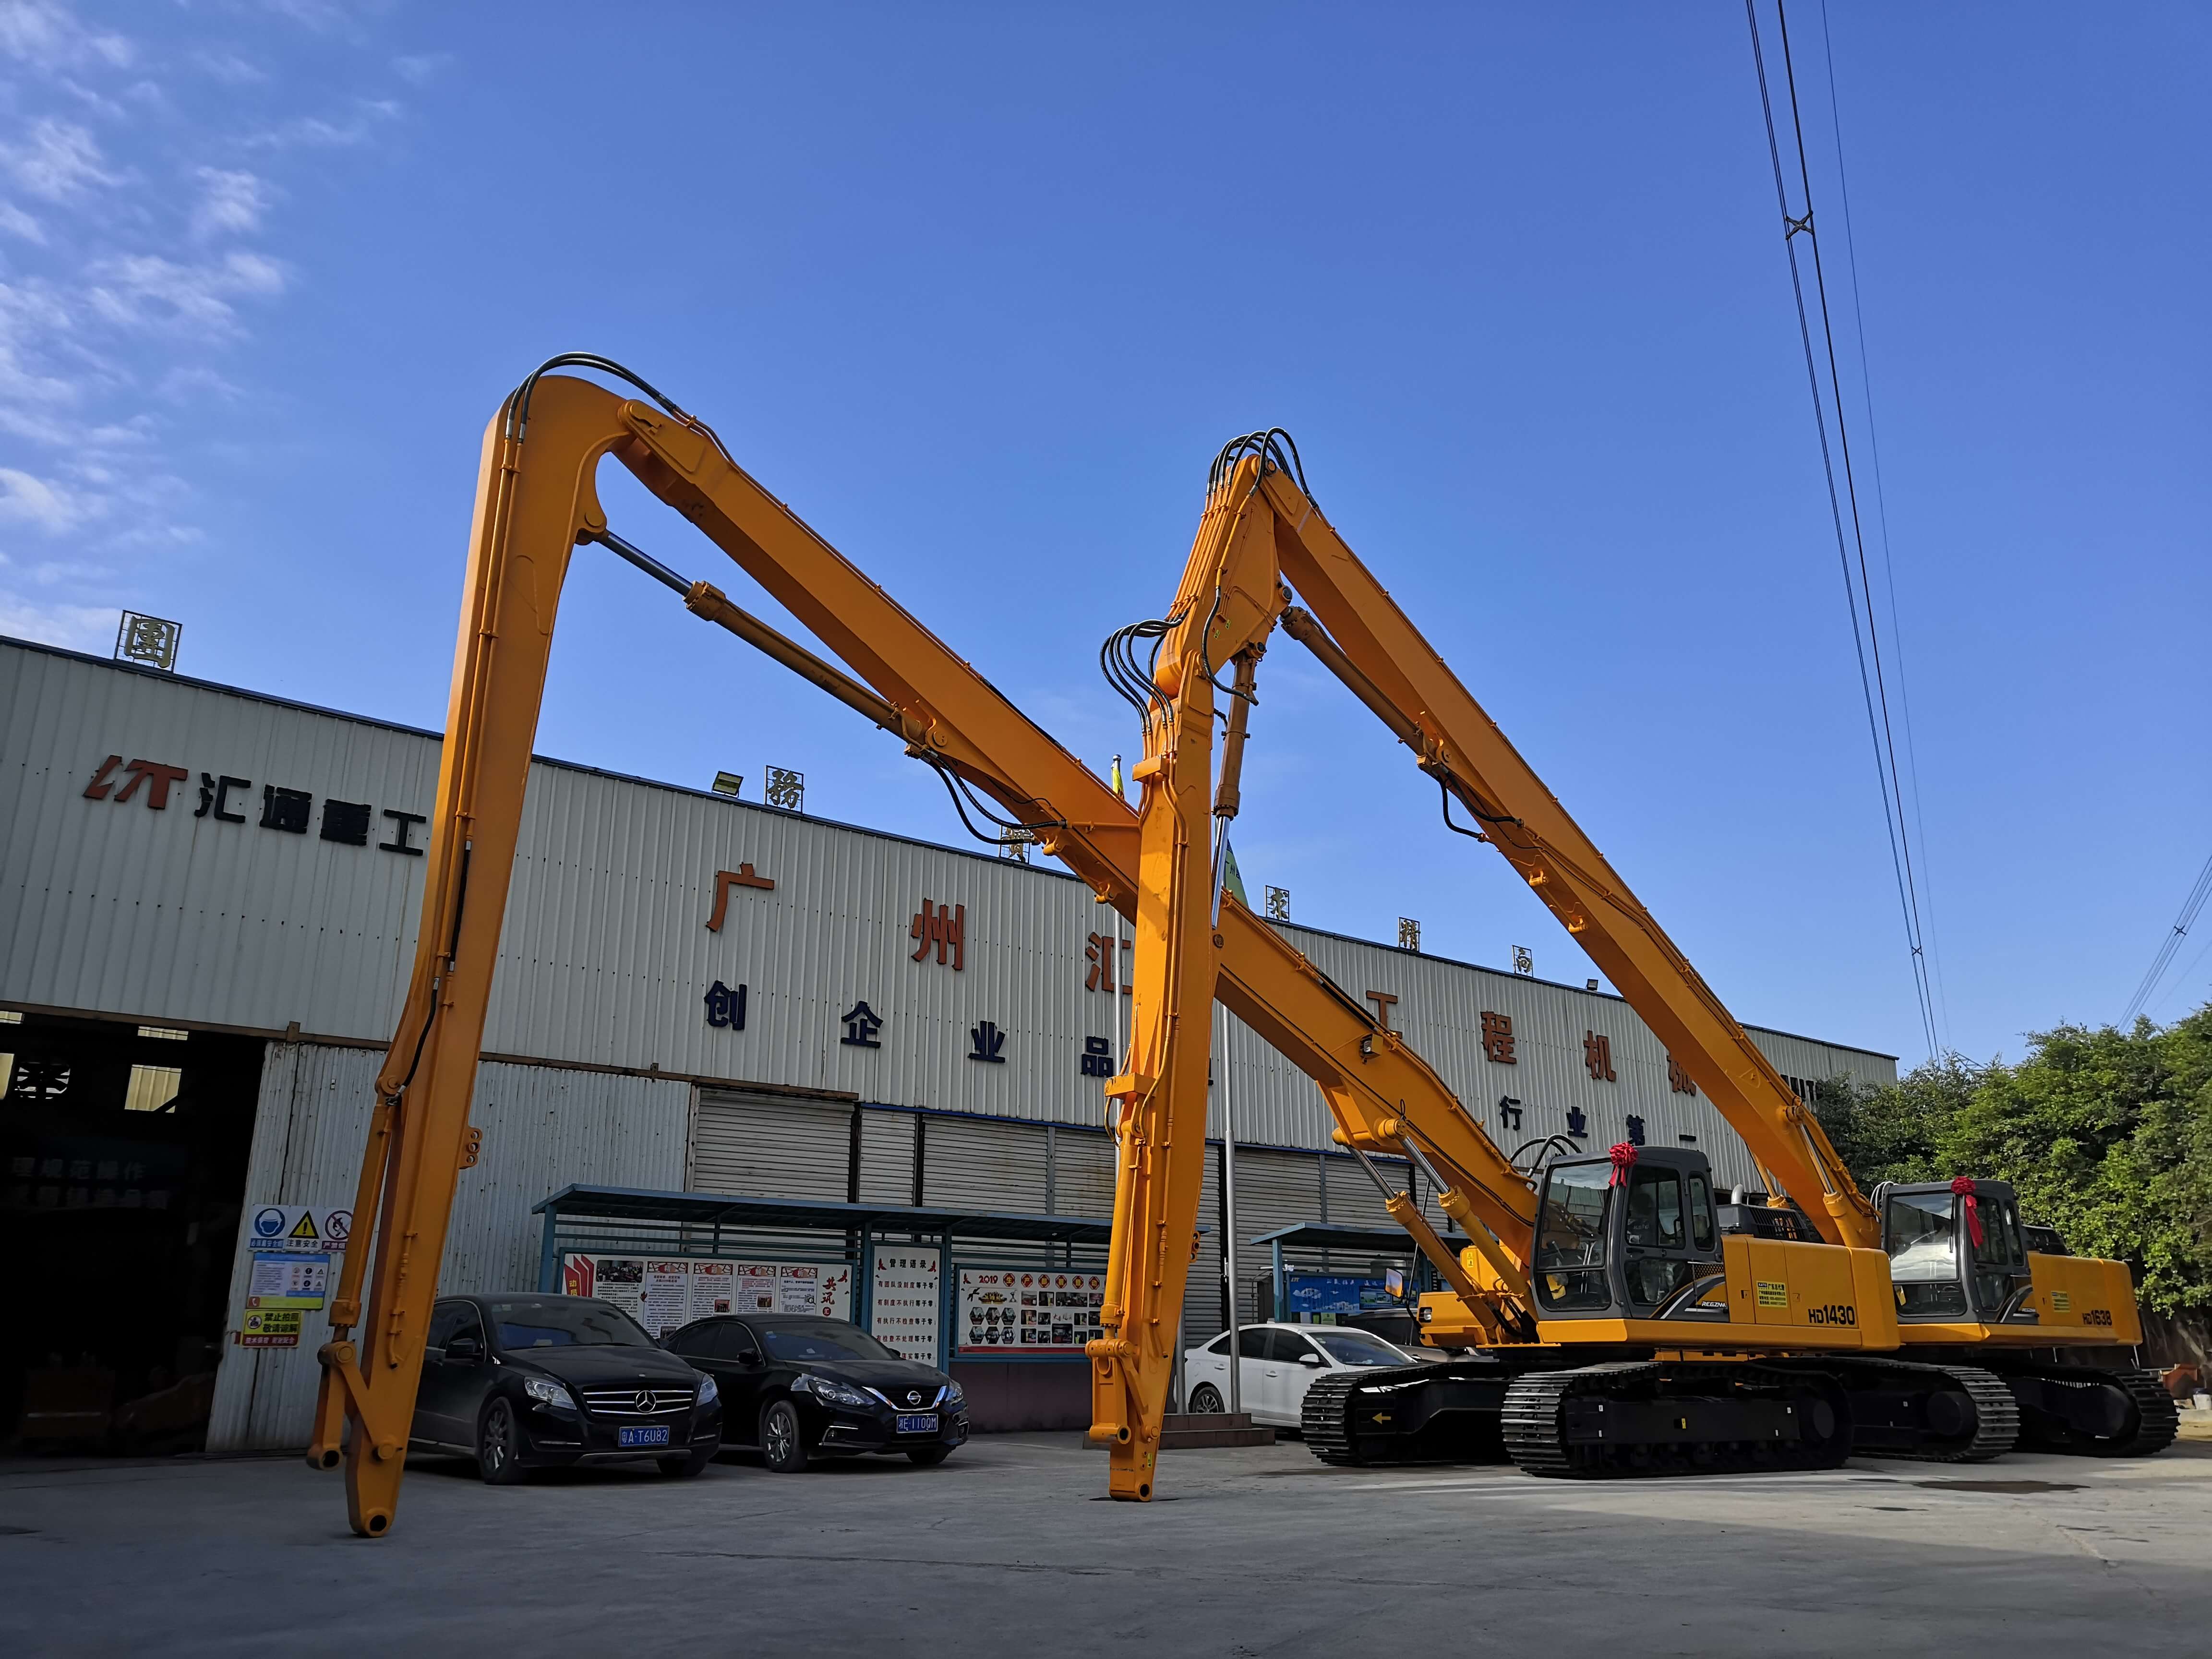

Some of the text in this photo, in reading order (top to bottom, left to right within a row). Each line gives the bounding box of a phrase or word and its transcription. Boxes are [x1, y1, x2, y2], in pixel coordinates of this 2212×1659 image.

[194, 772, 426, 856] 汇通重工
[287, 1239, 318, 1248] 注意安全
[890, 1259, 926, 1268] 管理语录
[978, 1275, 998, 1283] 2019
[1808, 1305, 1855, 1326] HD1430
[2082, 1310, 2112, 1325] HD1638
